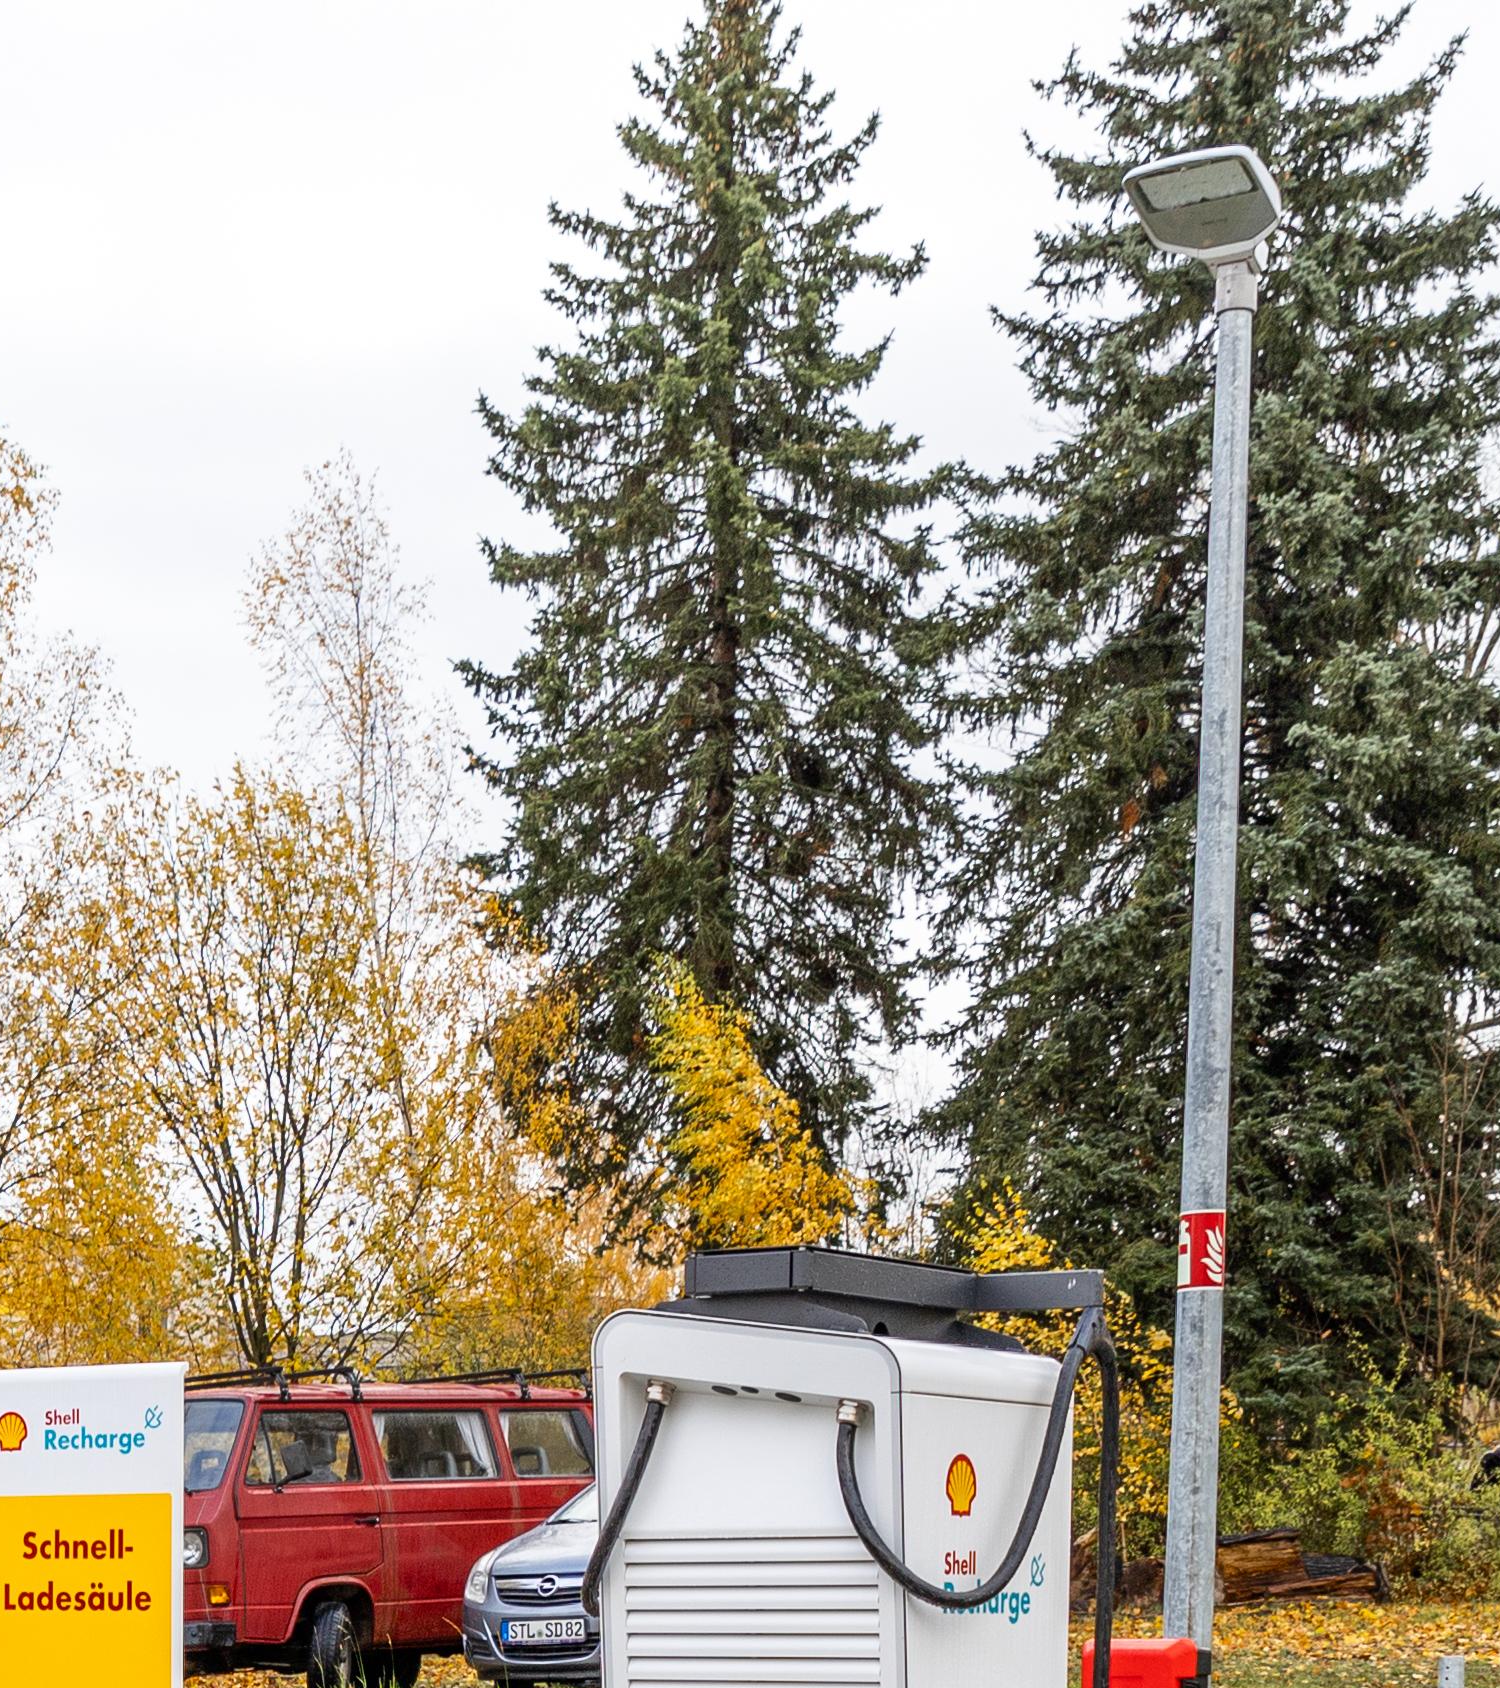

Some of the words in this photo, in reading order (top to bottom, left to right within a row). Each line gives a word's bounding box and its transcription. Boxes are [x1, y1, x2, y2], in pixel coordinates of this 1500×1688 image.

[45, 1408, 80, 1426] Shell
[44, 1426, 146, 1455] Recharge
[22, 1528, 134, 1560] Schnell-
[944, 1550, 977, 1576] Shell
[4, 1580, 152, 1611] Ladesäule
[510, 1623, 535, 1639] STL
[545, 1622, 563, 1638] SD
[565, 1621, 583, 1637] 82
